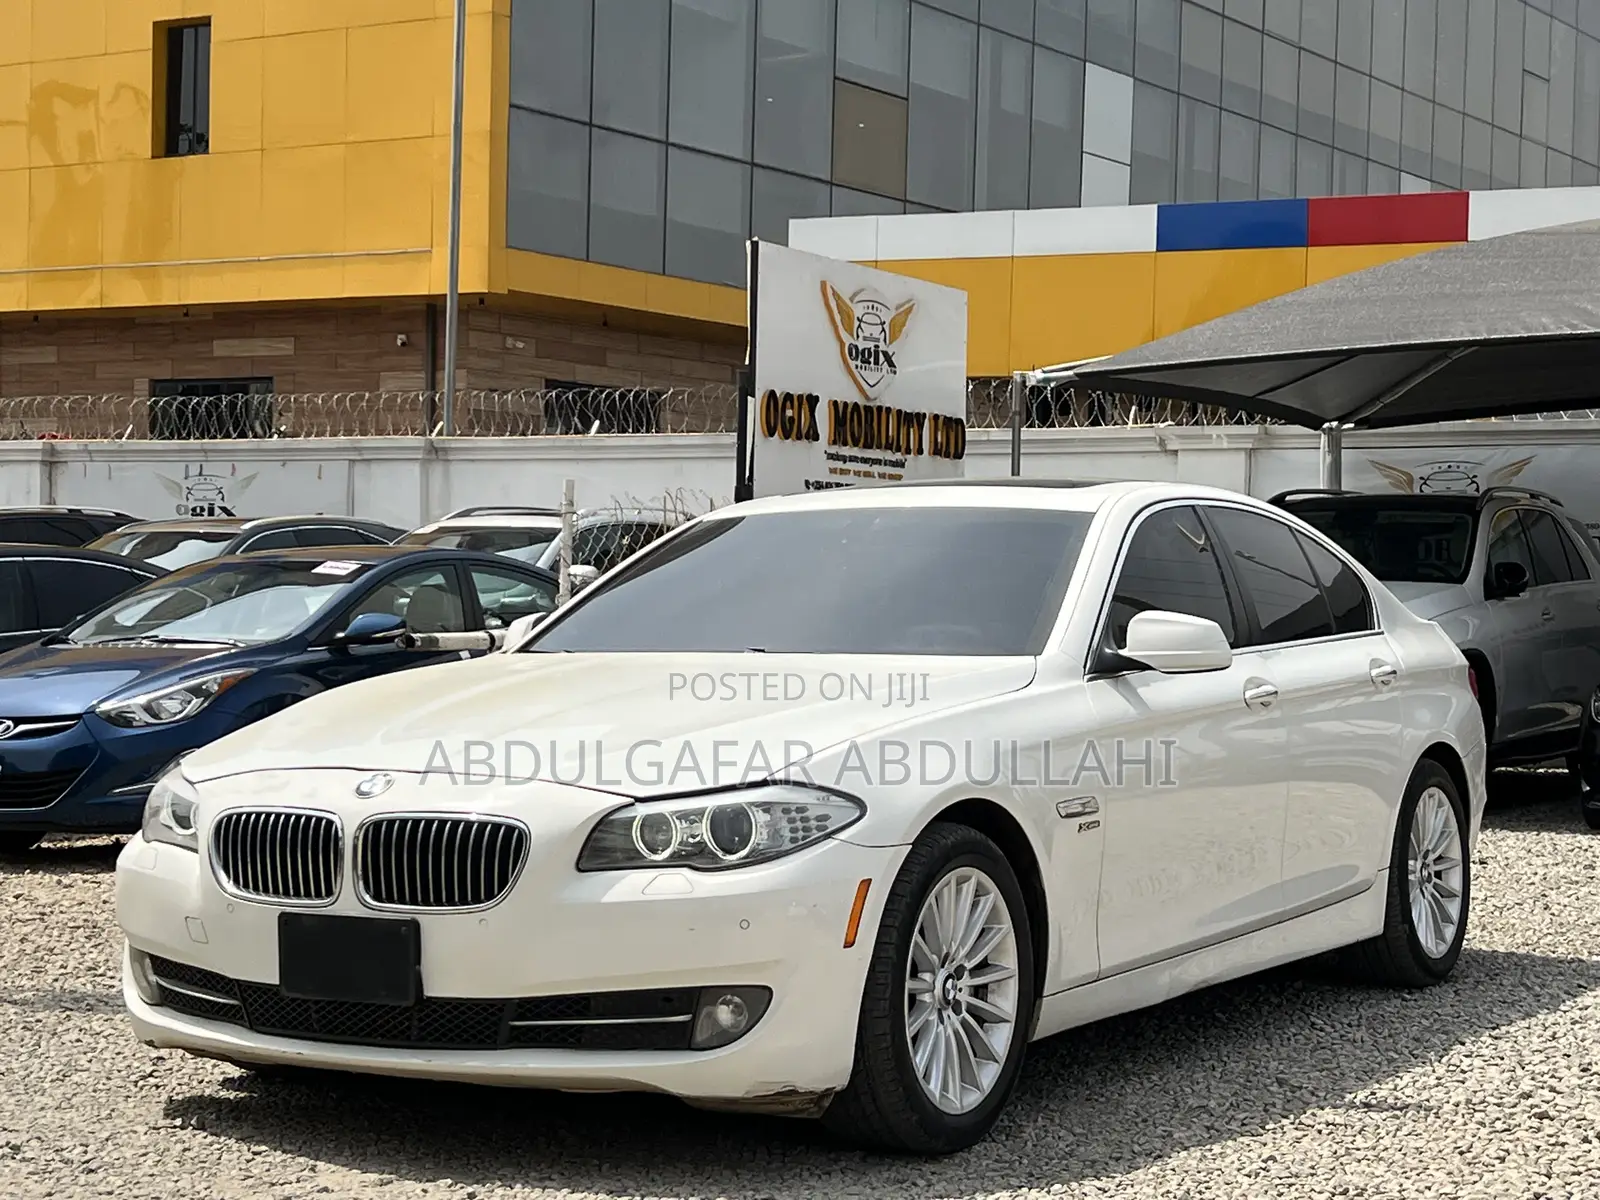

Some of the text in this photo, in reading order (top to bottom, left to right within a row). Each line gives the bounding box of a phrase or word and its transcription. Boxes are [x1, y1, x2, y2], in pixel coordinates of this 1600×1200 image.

[760, 389, 966, 460] OGIX MOBILITY LTD
